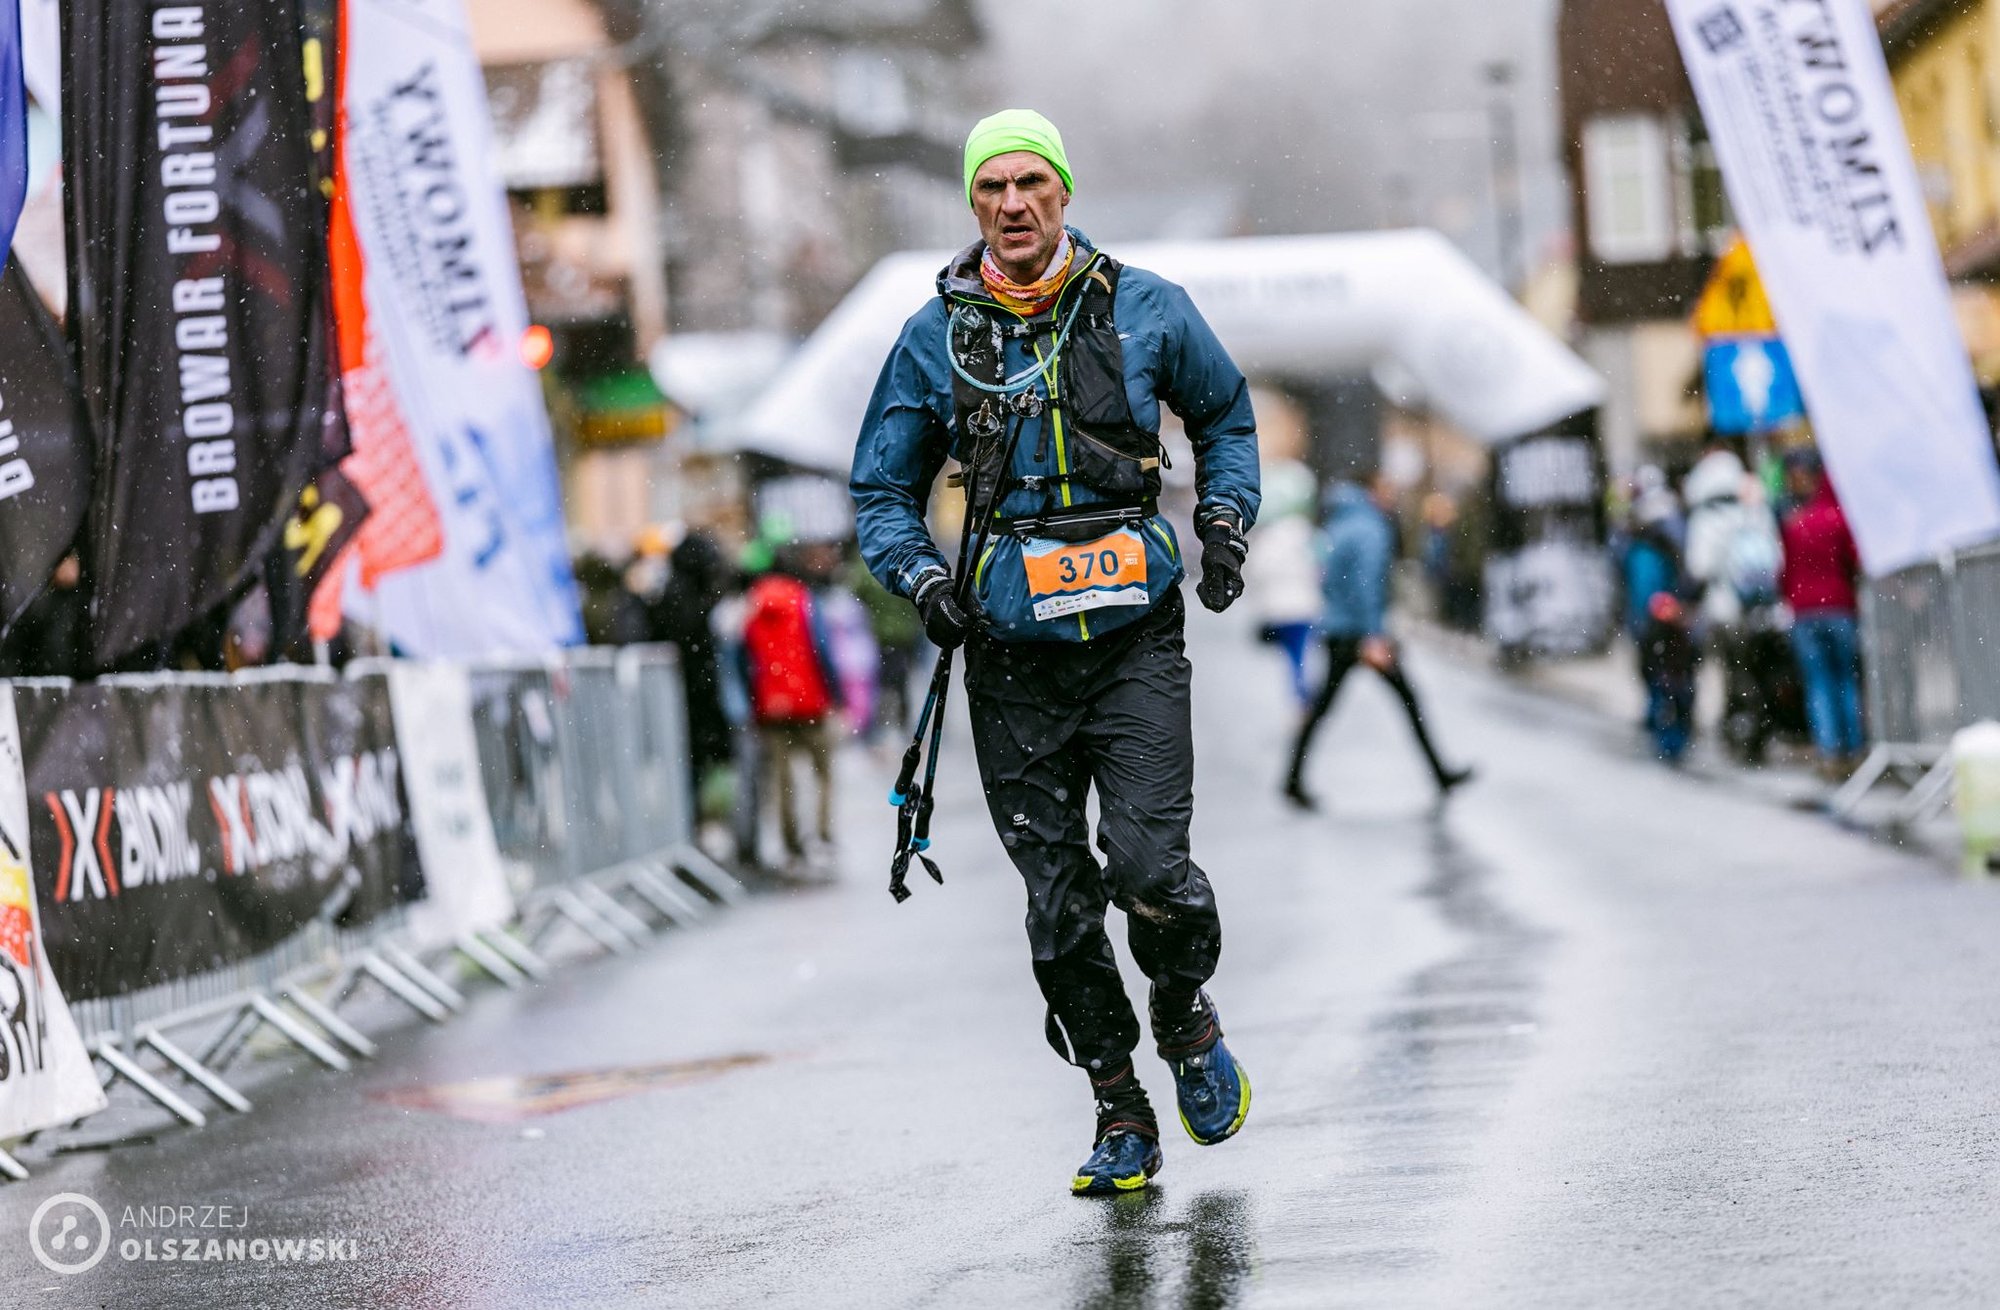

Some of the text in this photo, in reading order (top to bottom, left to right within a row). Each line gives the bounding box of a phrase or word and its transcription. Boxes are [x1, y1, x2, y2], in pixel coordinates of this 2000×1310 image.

[152, 6, 240, 514] BROWAR FORTUNA
[1058, 550, 1119, 584] 370
